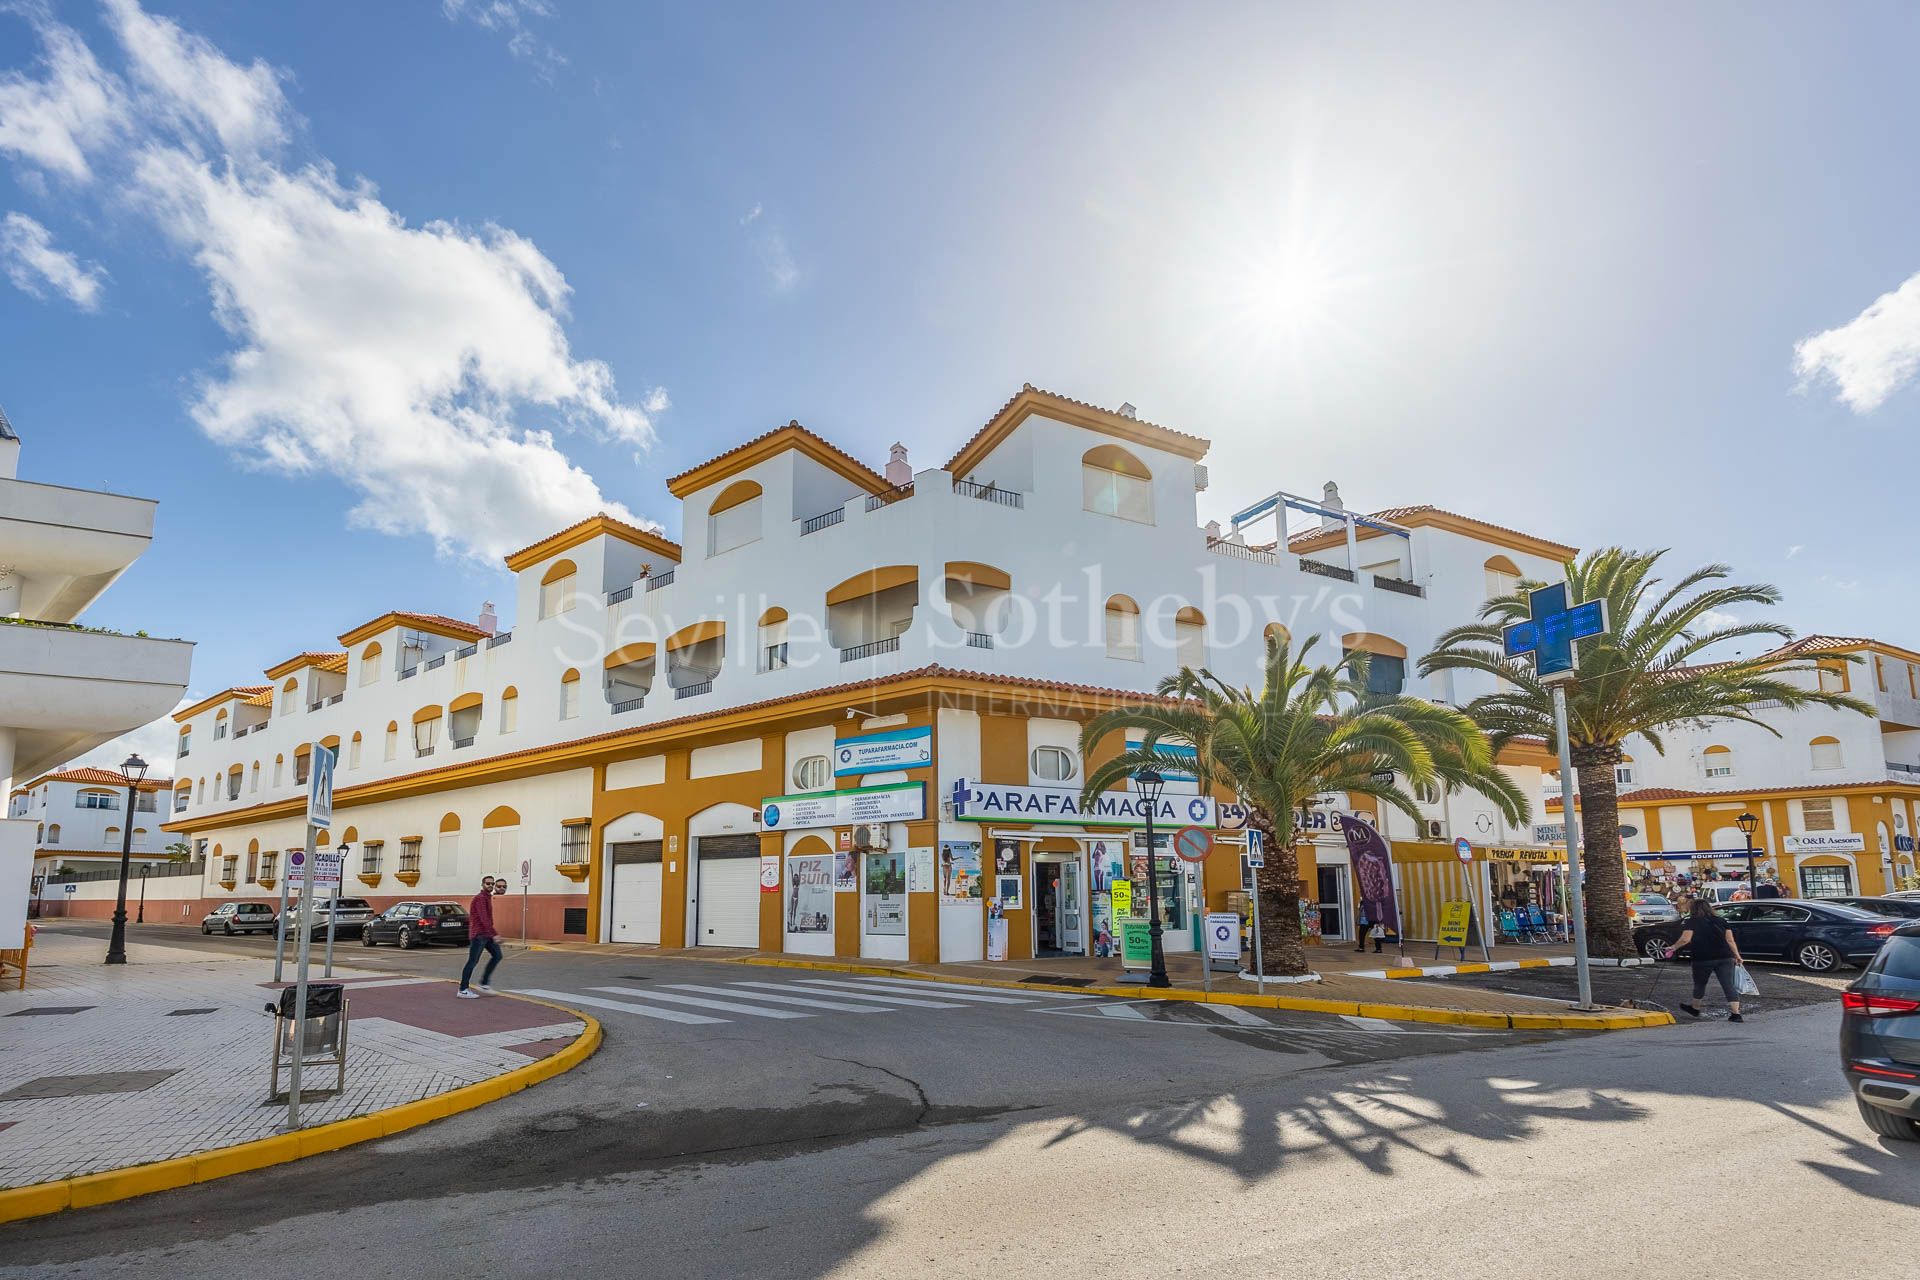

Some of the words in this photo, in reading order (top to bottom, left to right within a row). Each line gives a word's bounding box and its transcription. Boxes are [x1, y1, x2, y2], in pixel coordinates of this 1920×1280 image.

[858, 741, 918, 755] TUPARAFARMACIA.COM
[1219, 804, 1244, 819] 24
[1536, 826, 1557, 834] MINI
[1536, 833, 1568, 841] MARKE
[1802, 837, 1826, 845] O&R
[1491, 850, 1515, 859] PRENSA
[1519, 850, 1548, 859] REVISTAS
[799, 860, 822, 872] PIZ
